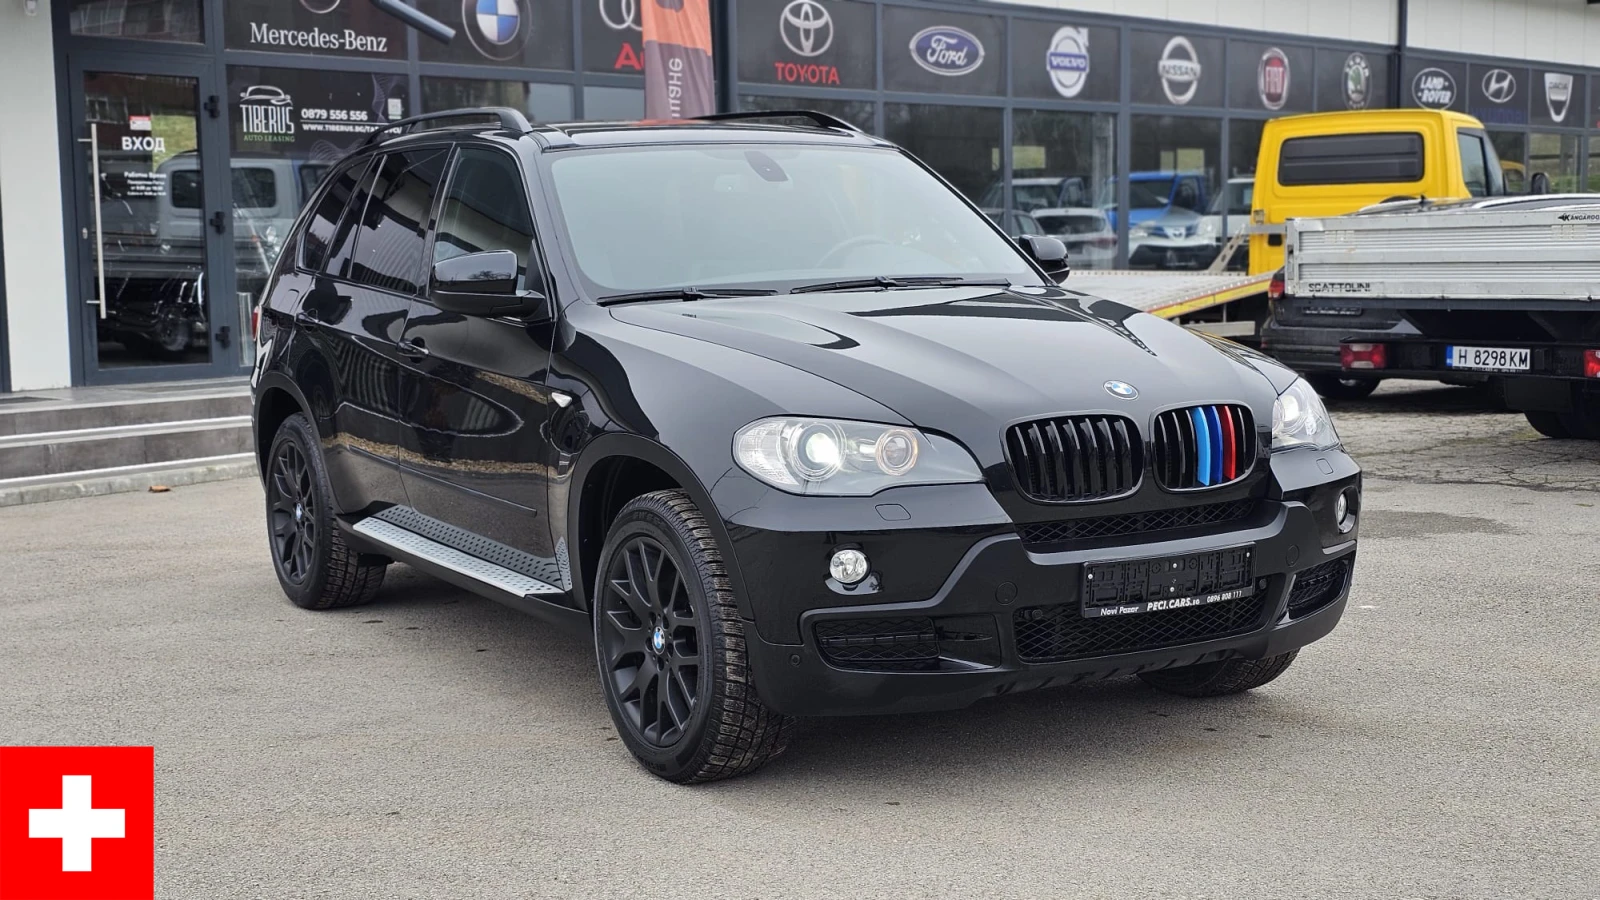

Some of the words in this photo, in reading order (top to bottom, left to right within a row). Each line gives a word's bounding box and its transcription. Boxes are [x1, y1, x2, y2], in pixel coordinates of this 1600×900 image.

[250, 22, 388, 52] Mercedes-Benz
[926, 35, 968, 66] Ford
[1051, 56, 1087, 69] VOLVO
[1161, 64, 1198, 77] NISSAN
[775, 62, 840, 85] TOYOTA
[1265, 66, 1284, 94] FIAT
[1420, 75, 1444, 90] LAND
[1421, 89, 1452, 104] ROVER
[240, 104, 295, 134] TIBERUS
[301, 108, 328, 119] 0879
[329, 109, 348, 120] 556
[349, 110, 368, 121] 556
[121, 136, 166, 153] ВХОД
[243, 134, 263, 142] AUTO
[264, 134, 295, 142] LEASING
[1458, 349, 1468, 365] H
[1100, 608, 1118, 617] Novi
[1119, 605, 1140, 615] Pazar
[1206, 594, 1221, 604] 0896
